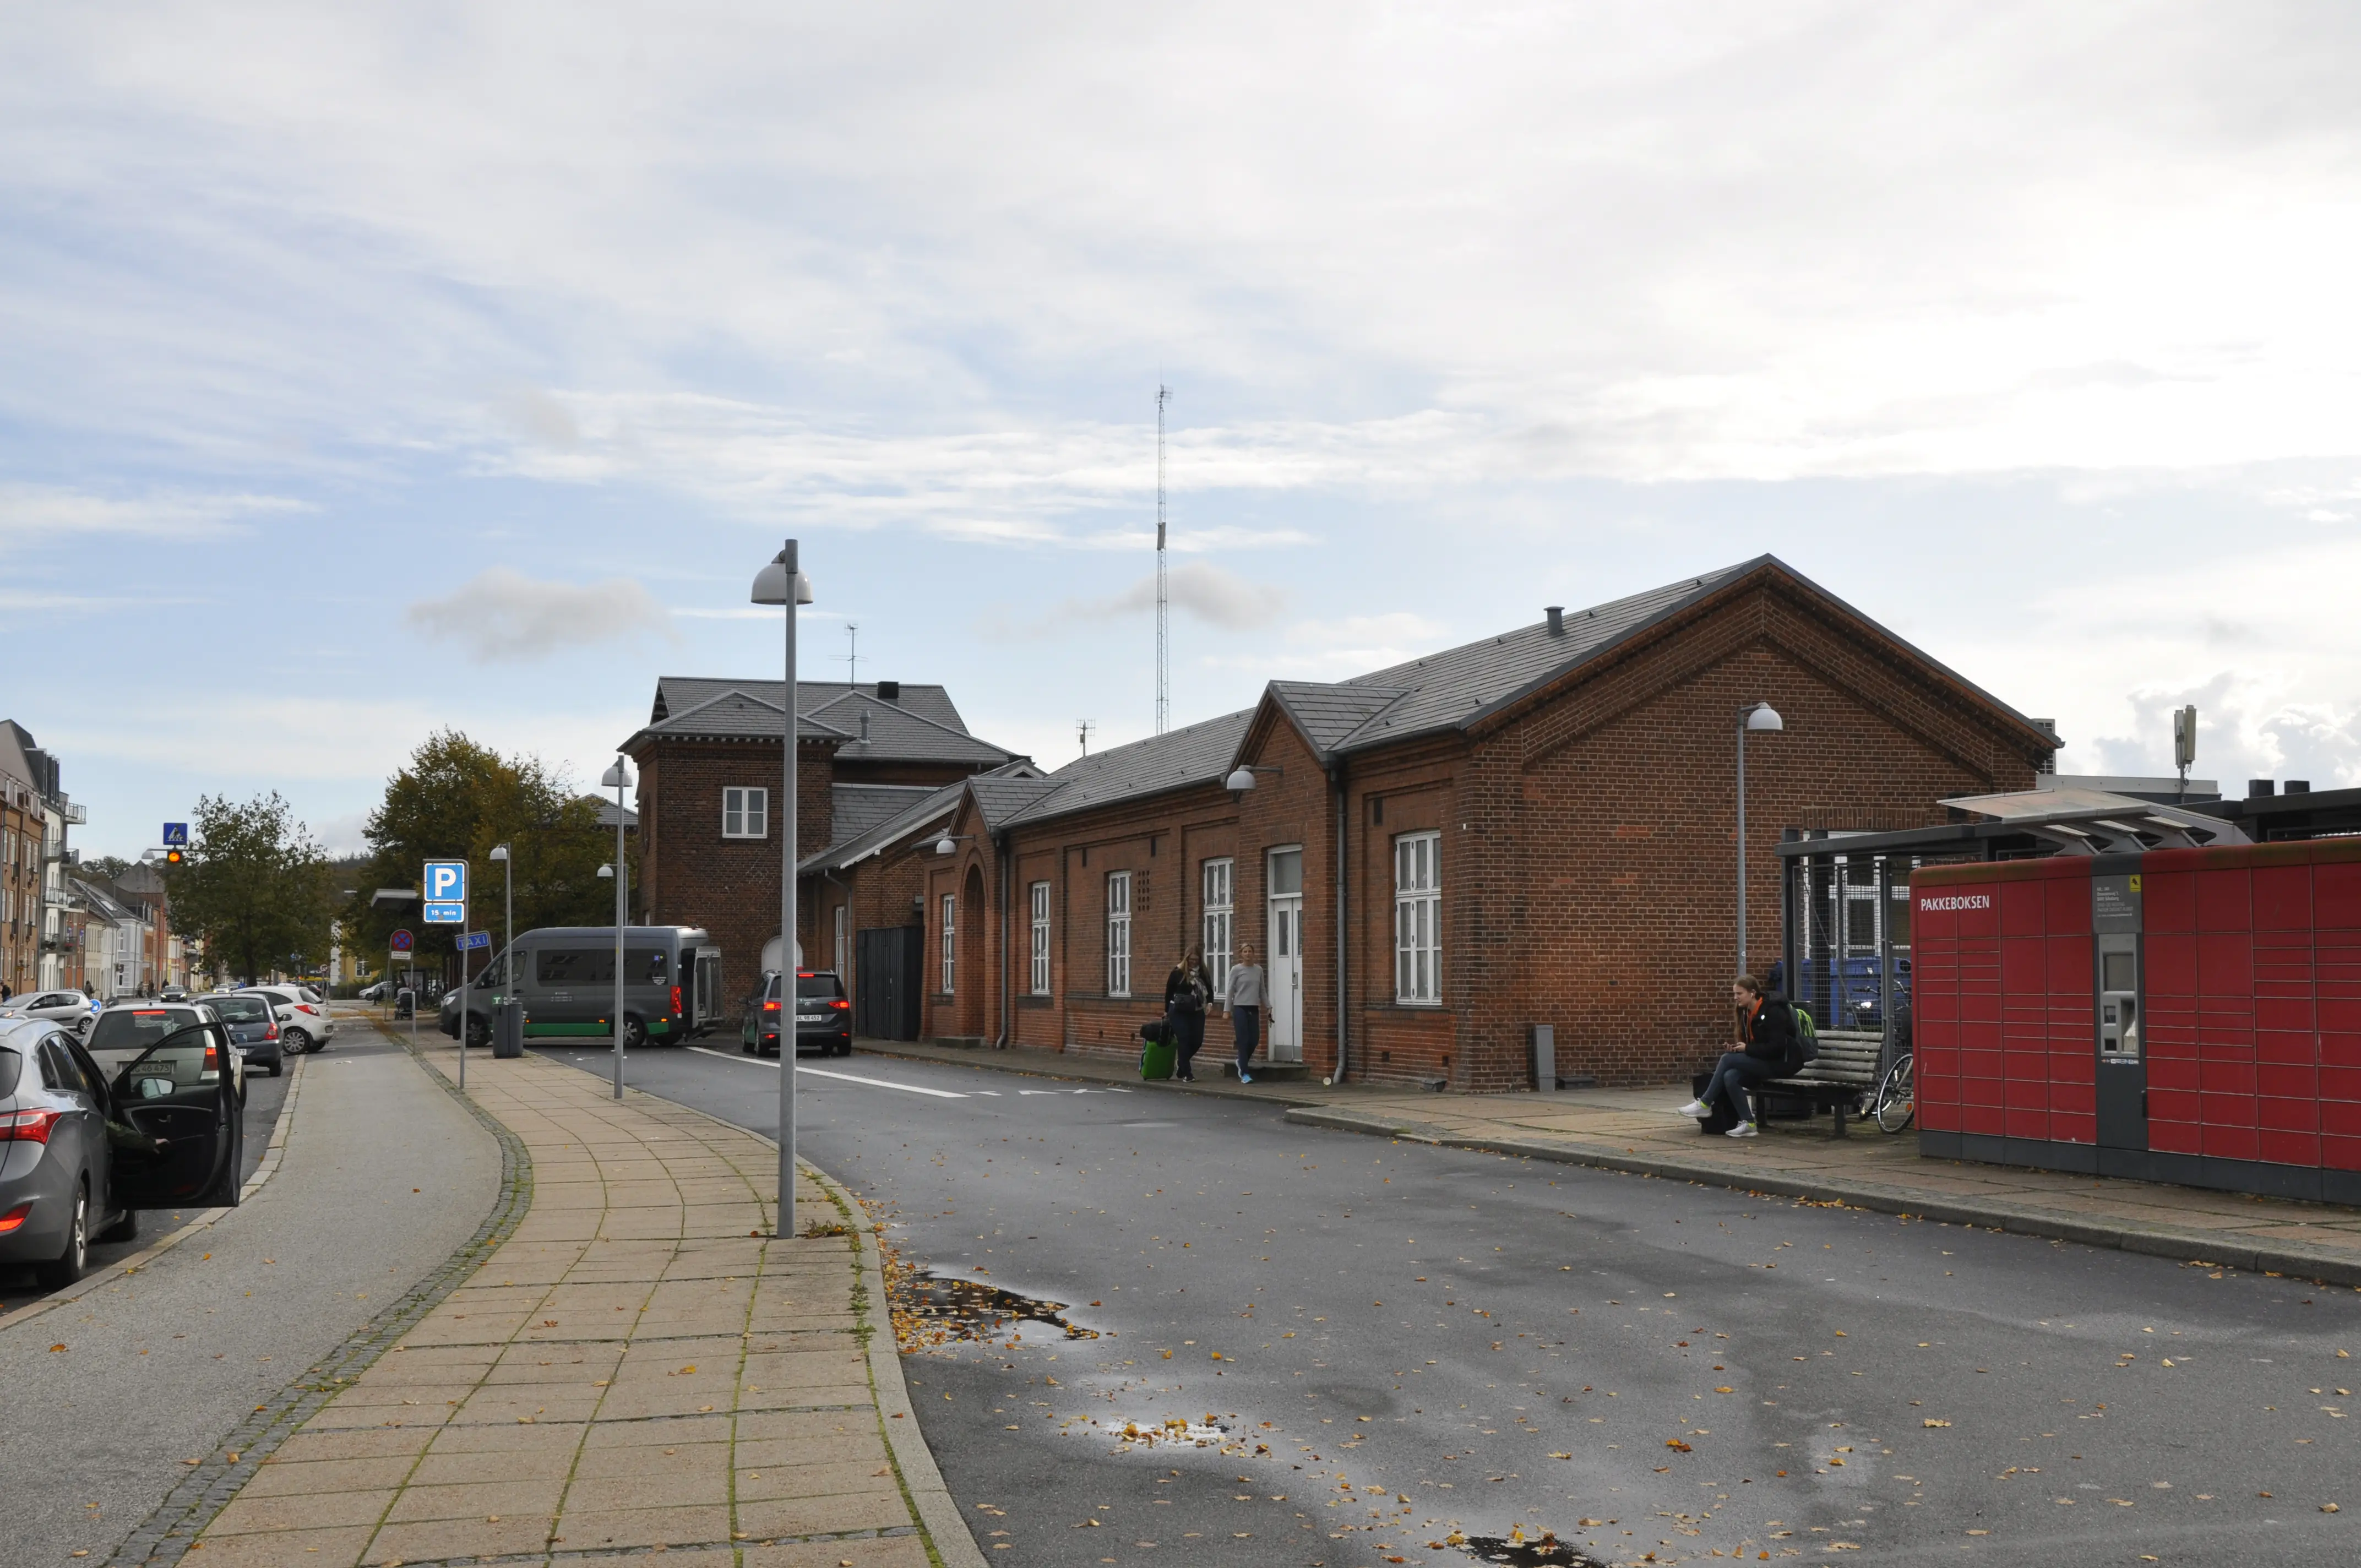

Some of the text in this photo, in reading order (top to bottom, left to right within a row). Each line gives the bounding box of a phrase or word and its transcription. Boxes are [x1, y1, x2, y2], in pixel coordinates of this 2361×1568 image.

[435, 868, 456, 897] P
[1921, 895, 1990, 911] PAKKEBOKSEN
[458, 935, 486, 948] TAXI
